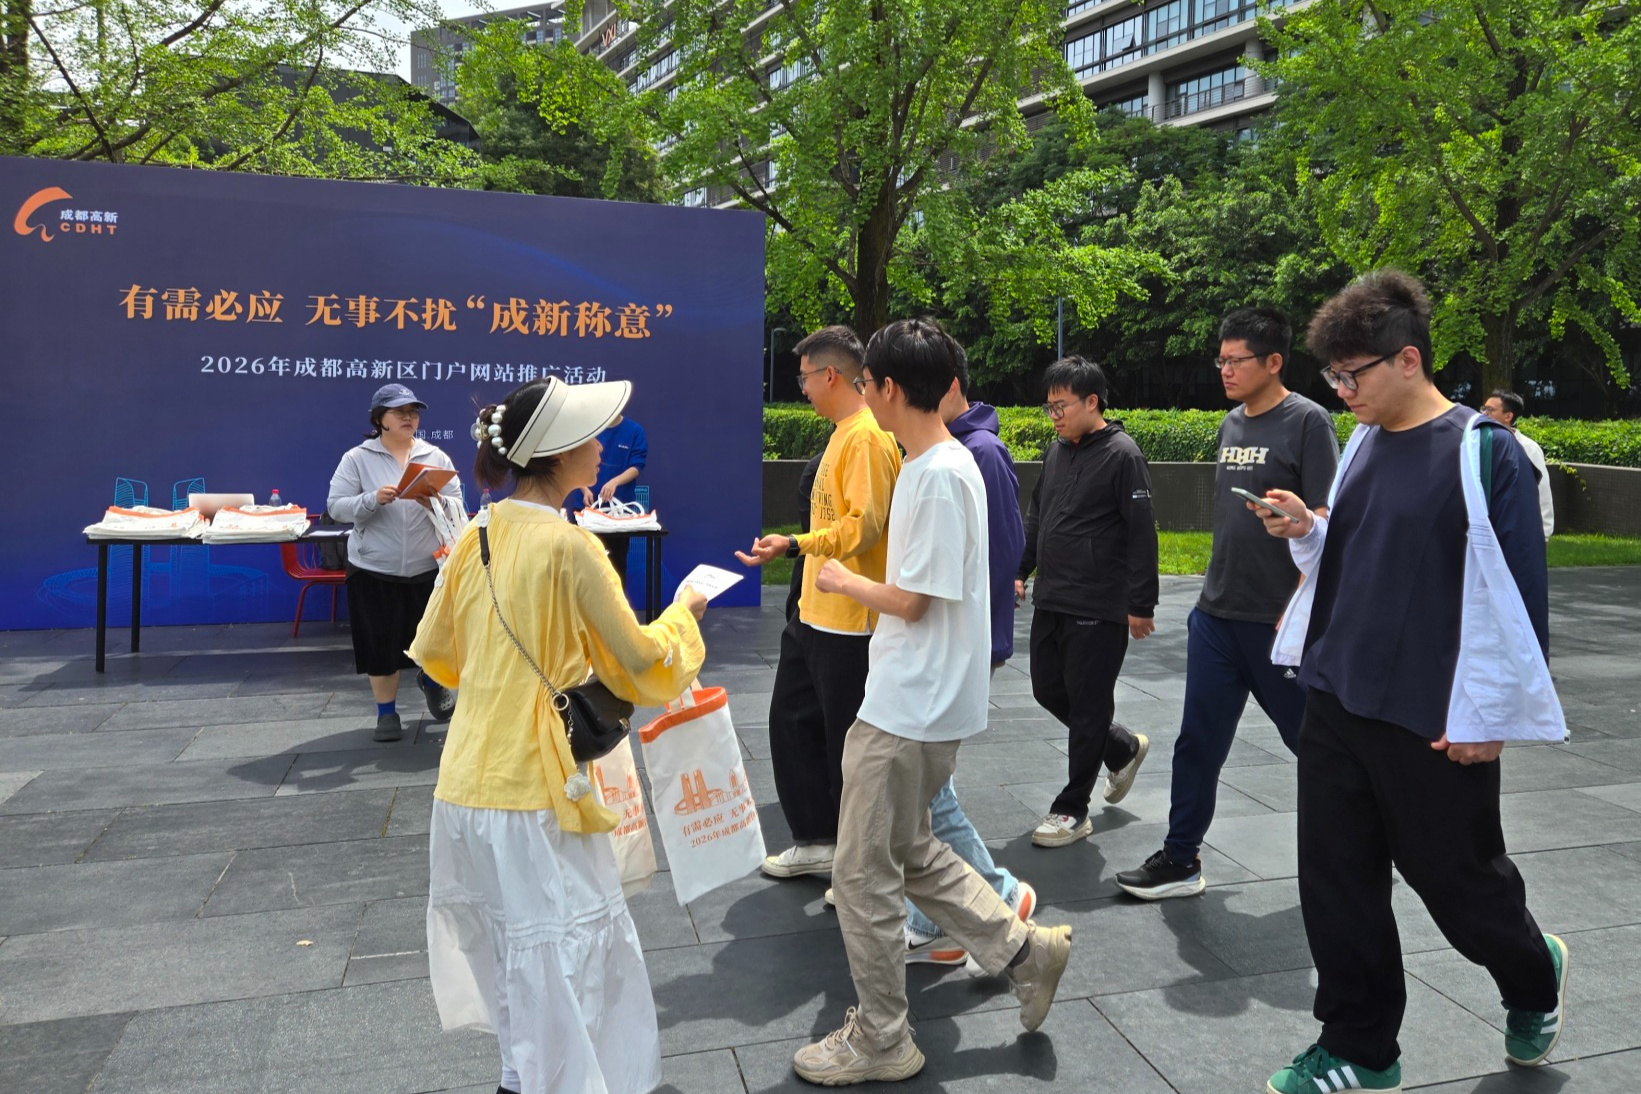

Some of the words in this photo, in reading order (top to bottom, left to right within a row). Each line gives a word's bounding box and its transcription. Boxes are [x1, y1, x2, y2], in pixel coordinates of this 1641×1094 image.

[60, 209, 119, 224] 成都高新
[60, 222, 117, 235] CDHT
[119, 284, 284, 323] 有需必应
[681, 812, 725, 838] 有需必应
